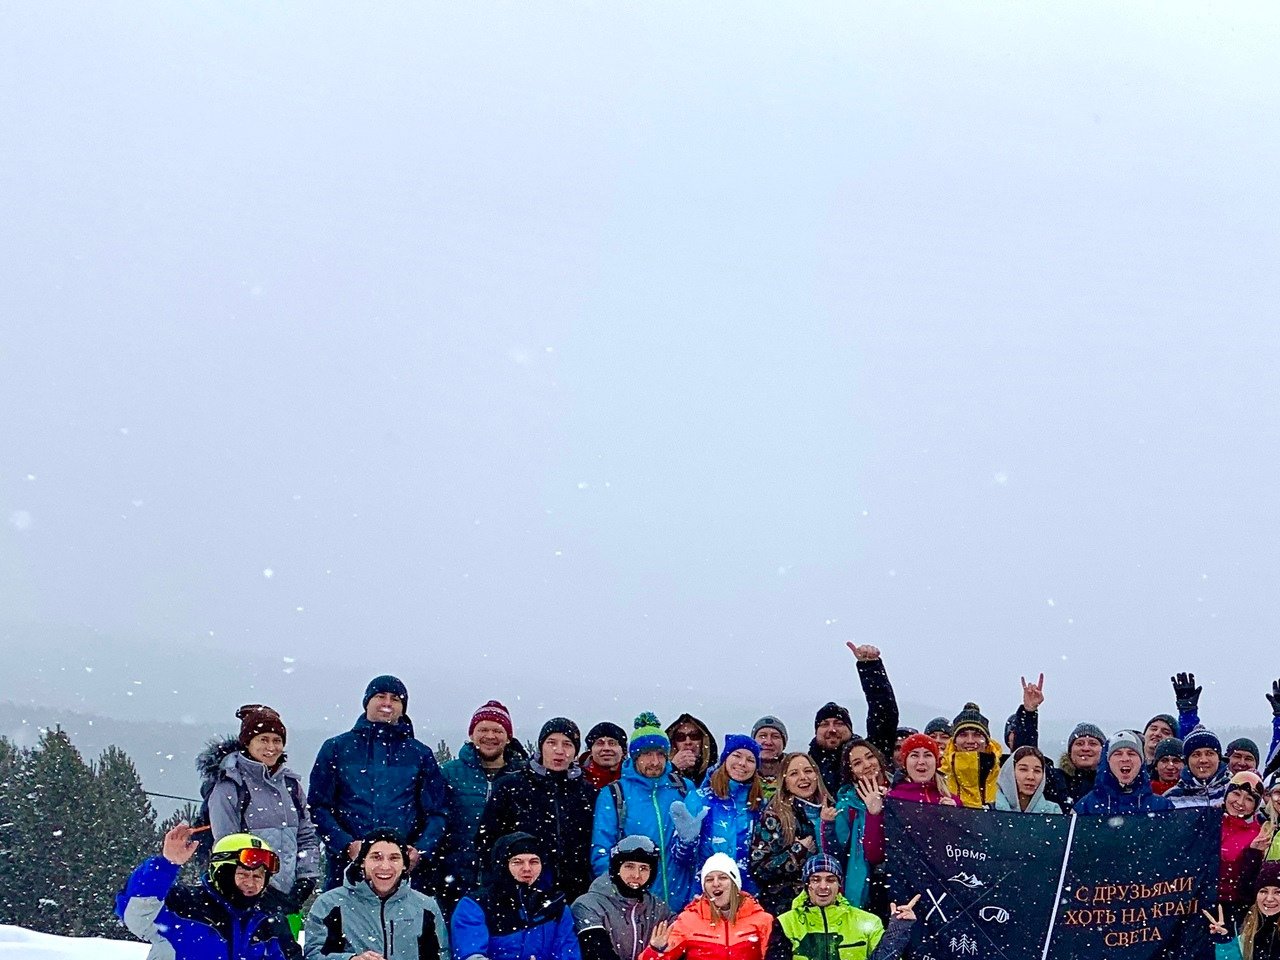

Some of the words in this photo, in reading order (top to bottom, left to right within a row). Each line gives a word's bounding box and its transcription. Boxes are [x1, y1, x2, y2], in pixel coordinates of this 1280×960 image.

[945, 844, 987, 861] Время
[1074, 886, 1090, 902] С
[1092, 876, 1194, 906] ДРУЗЬЯМИ
[1065, 908, 1116, 926] ХОТЬ
[1121, 907, 1149, 925] НА
[1152, 897, 1199, 919] КРАЙ
[1104, 926, 1163, 947] СВЕТА
